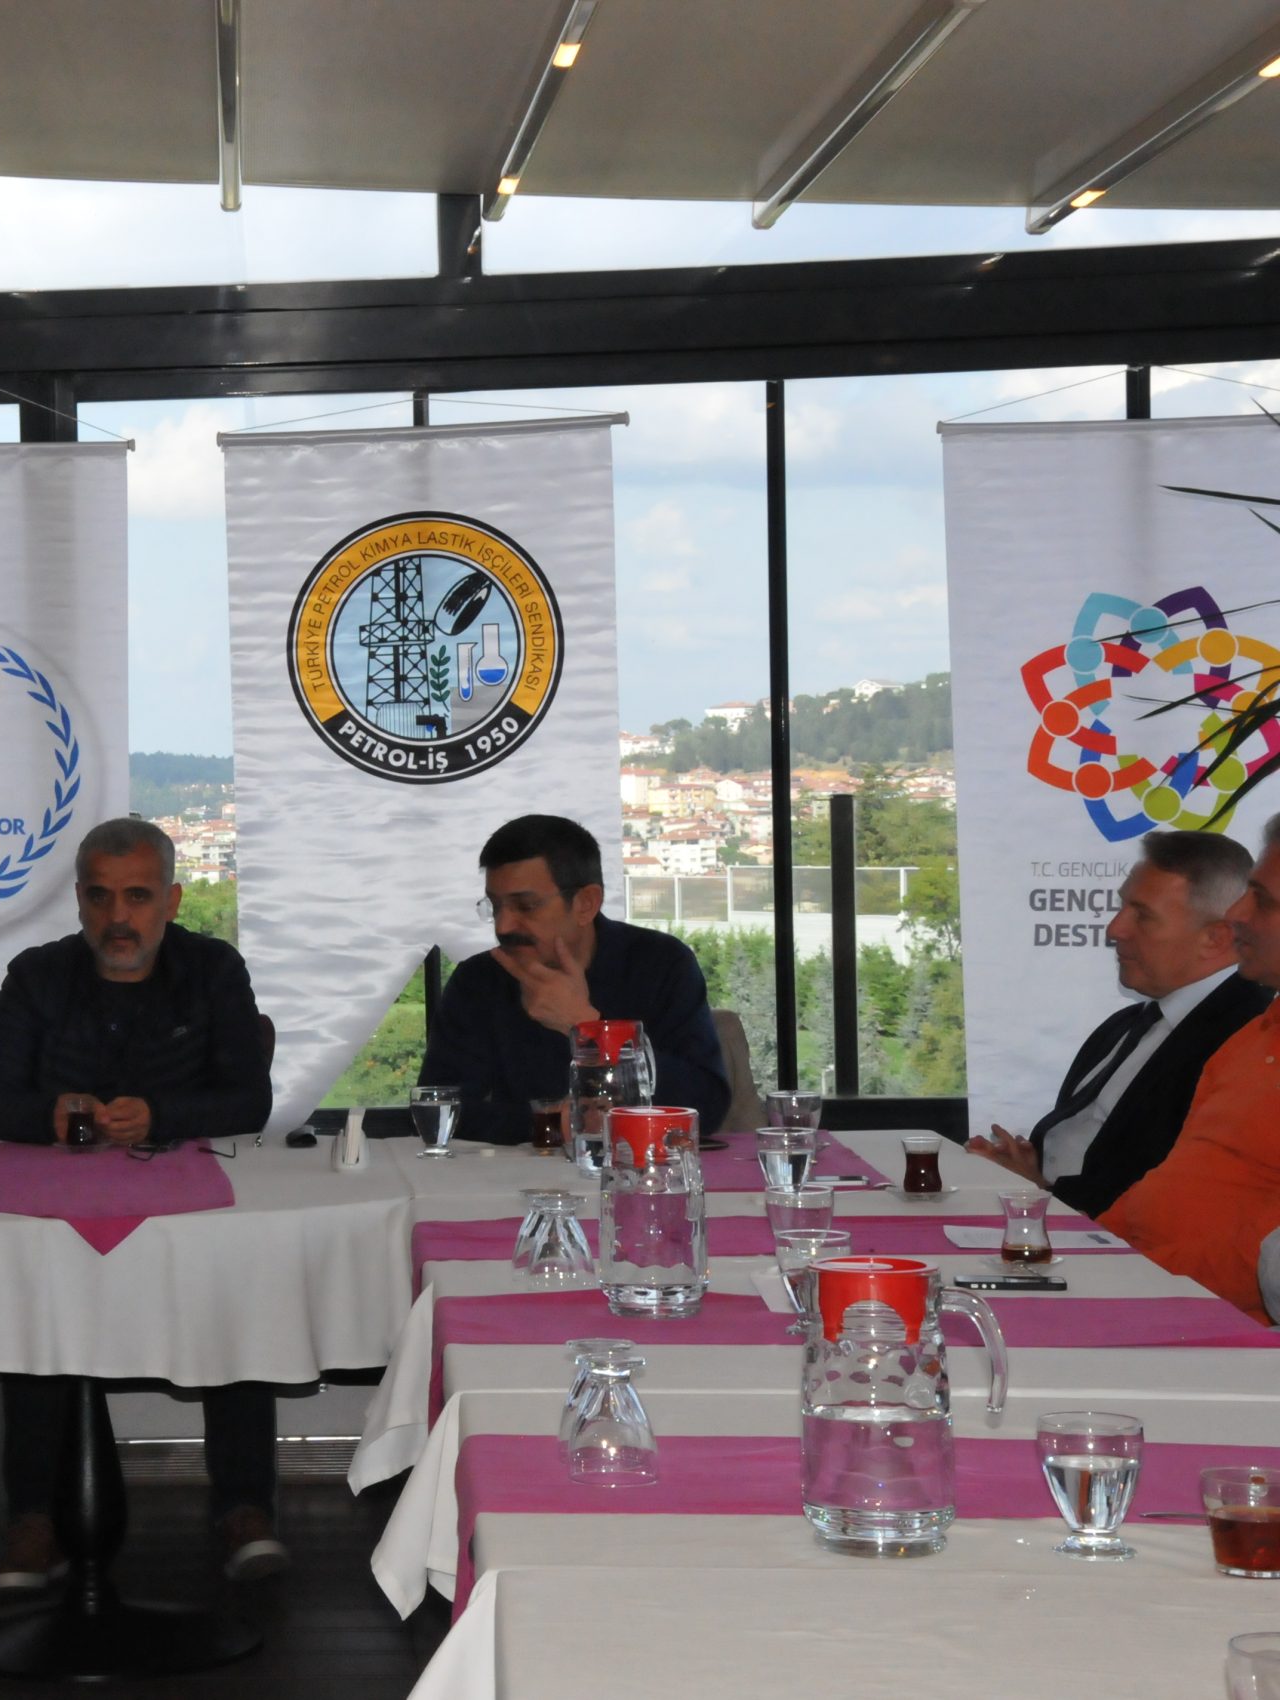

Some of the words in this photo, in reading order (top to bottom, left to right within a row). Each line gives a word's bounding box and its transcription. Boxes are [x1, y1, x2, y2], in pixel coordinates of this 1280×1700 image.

[359, 532, 412, 562] KİMYA
[417, 530, 477, 553] LASTİK
[312, 560, 360, 615] PETROL
[477, 542, 534, 599] İŞÇİLERİ
[304, 618, 325, 693] TÜRKİYE
[524, 601, 549, 691] SENDİKASI
[338, 720, 449, 773] PETROL-İŞ
[464, 716, 520, 762] 1950
[1029, 888, 1122, 918] GENÇL
